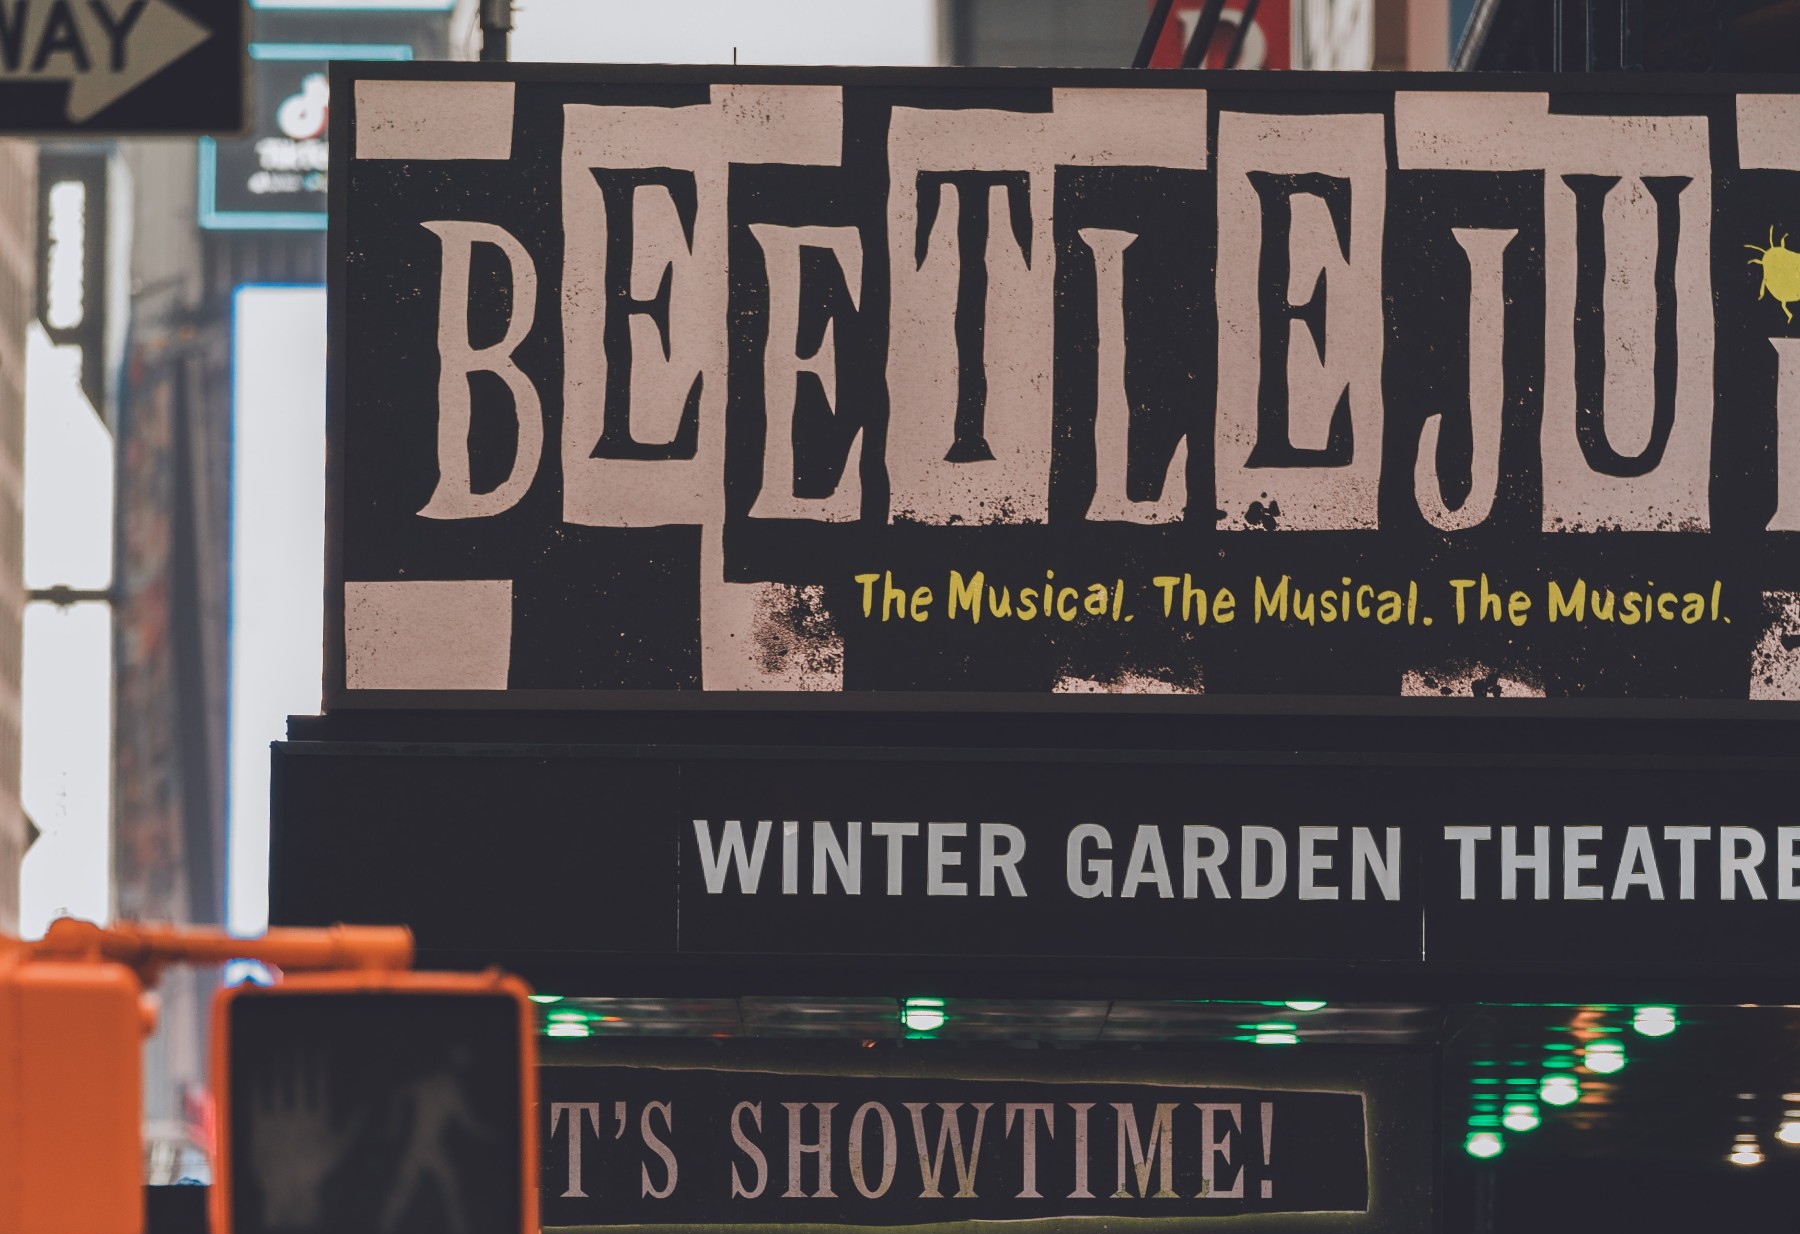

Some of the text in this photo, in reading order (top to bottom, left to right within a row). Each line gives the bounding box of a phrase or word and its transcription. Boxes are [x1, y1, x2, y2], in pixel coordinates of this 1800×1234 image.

[854, 570, 1731, 626] The Musical. The Musical. The Musical.
[693, 819, 1800, 901] WINTER GARDEN THEATRE
[534, 1100, 1274, 1201] T'S SHOWTIME!
